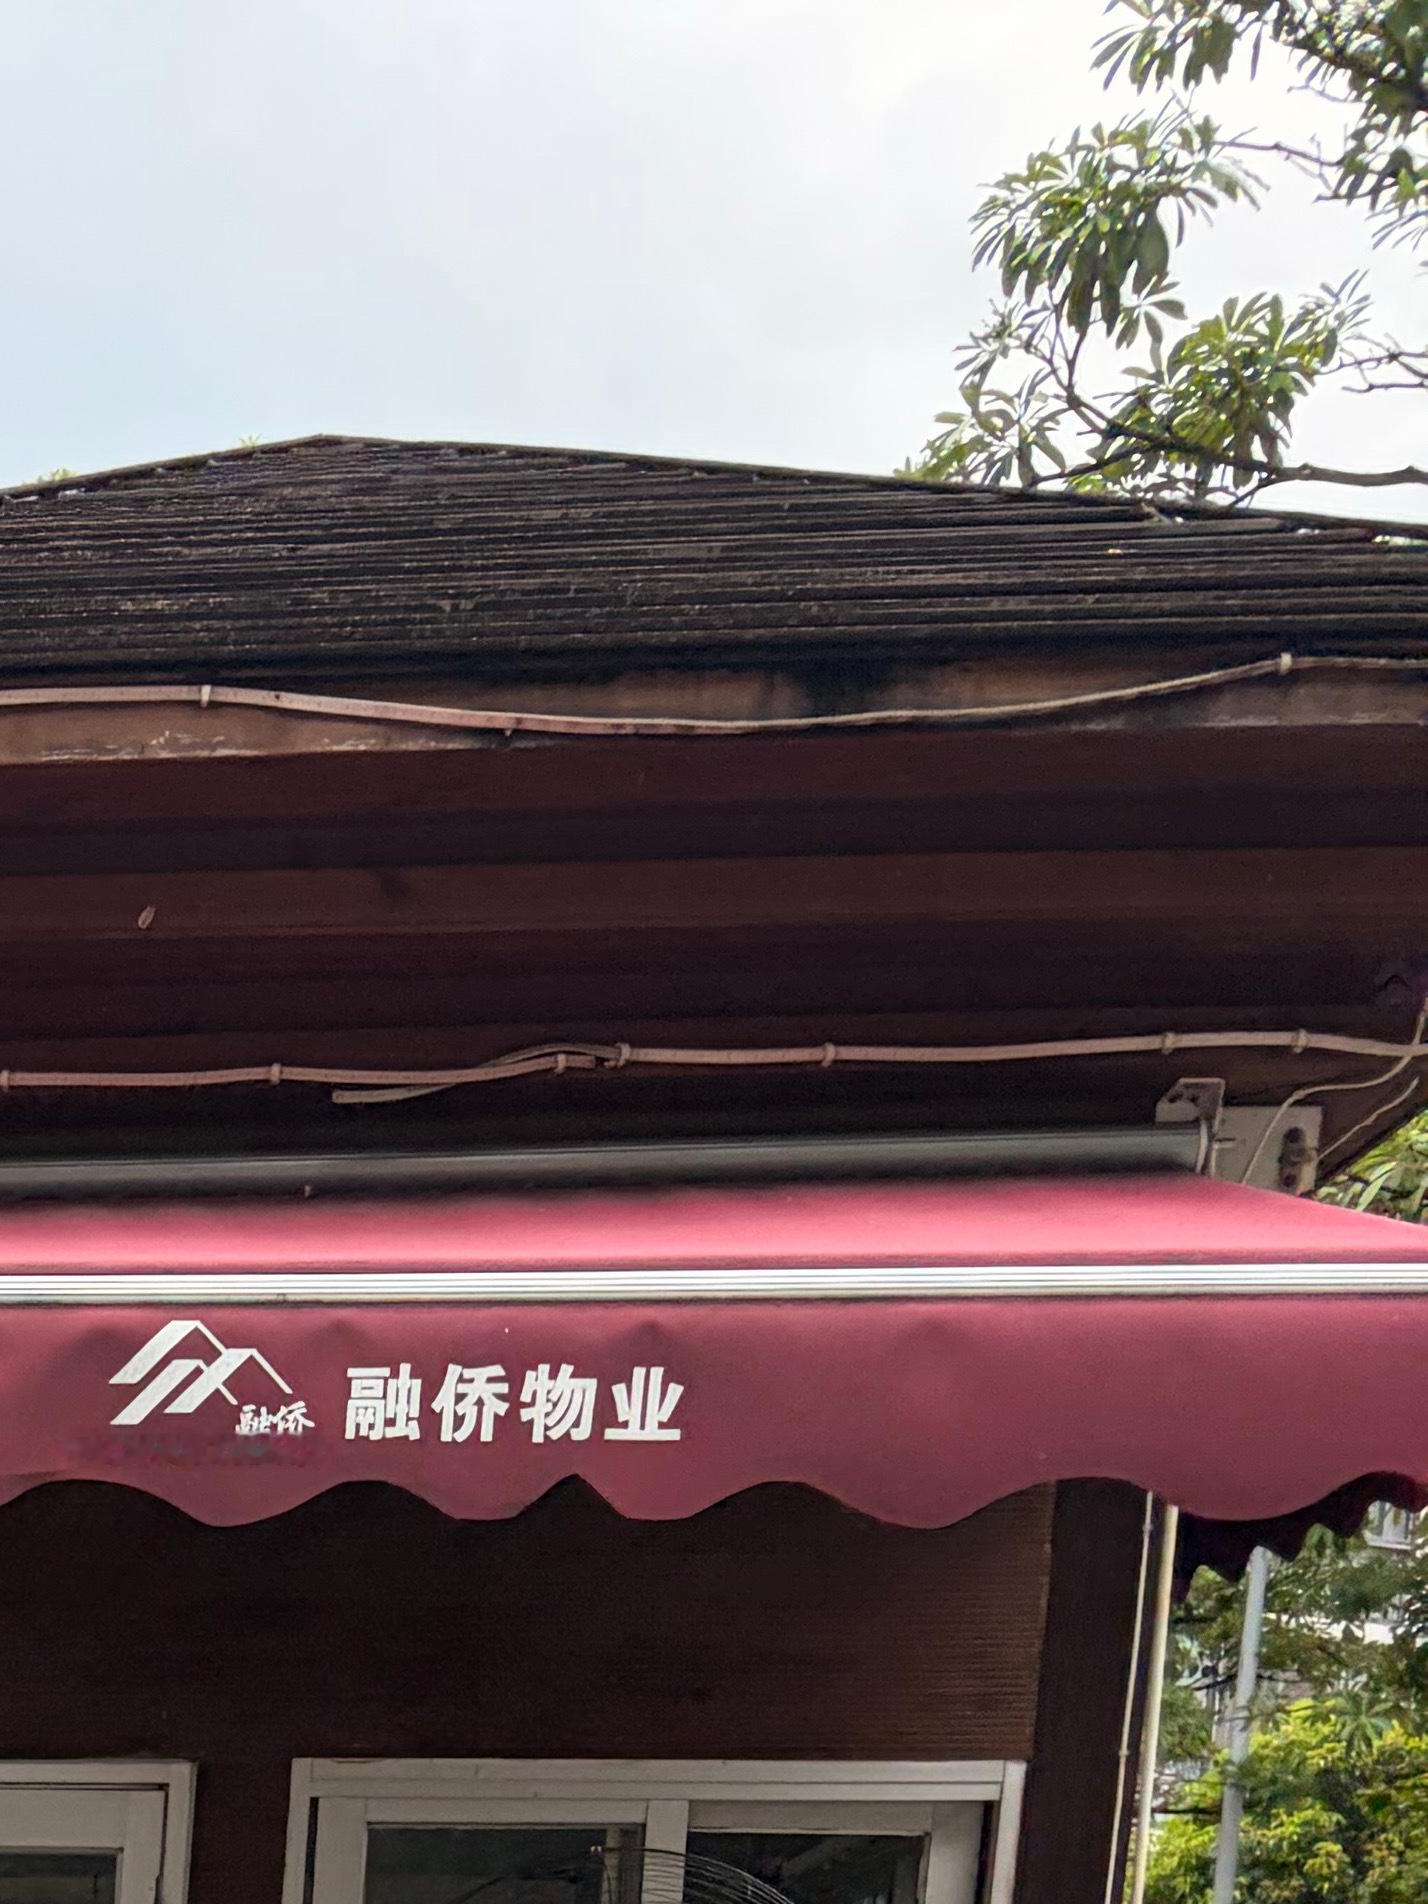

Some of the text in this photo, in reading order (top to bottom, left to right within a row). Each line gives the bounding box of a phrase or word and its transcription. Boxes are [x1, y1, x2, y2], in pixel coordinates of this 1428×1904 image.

[234, 1400, 316, 1436] 融侨
[344, 1362, 685, 1444] 融侨物业
